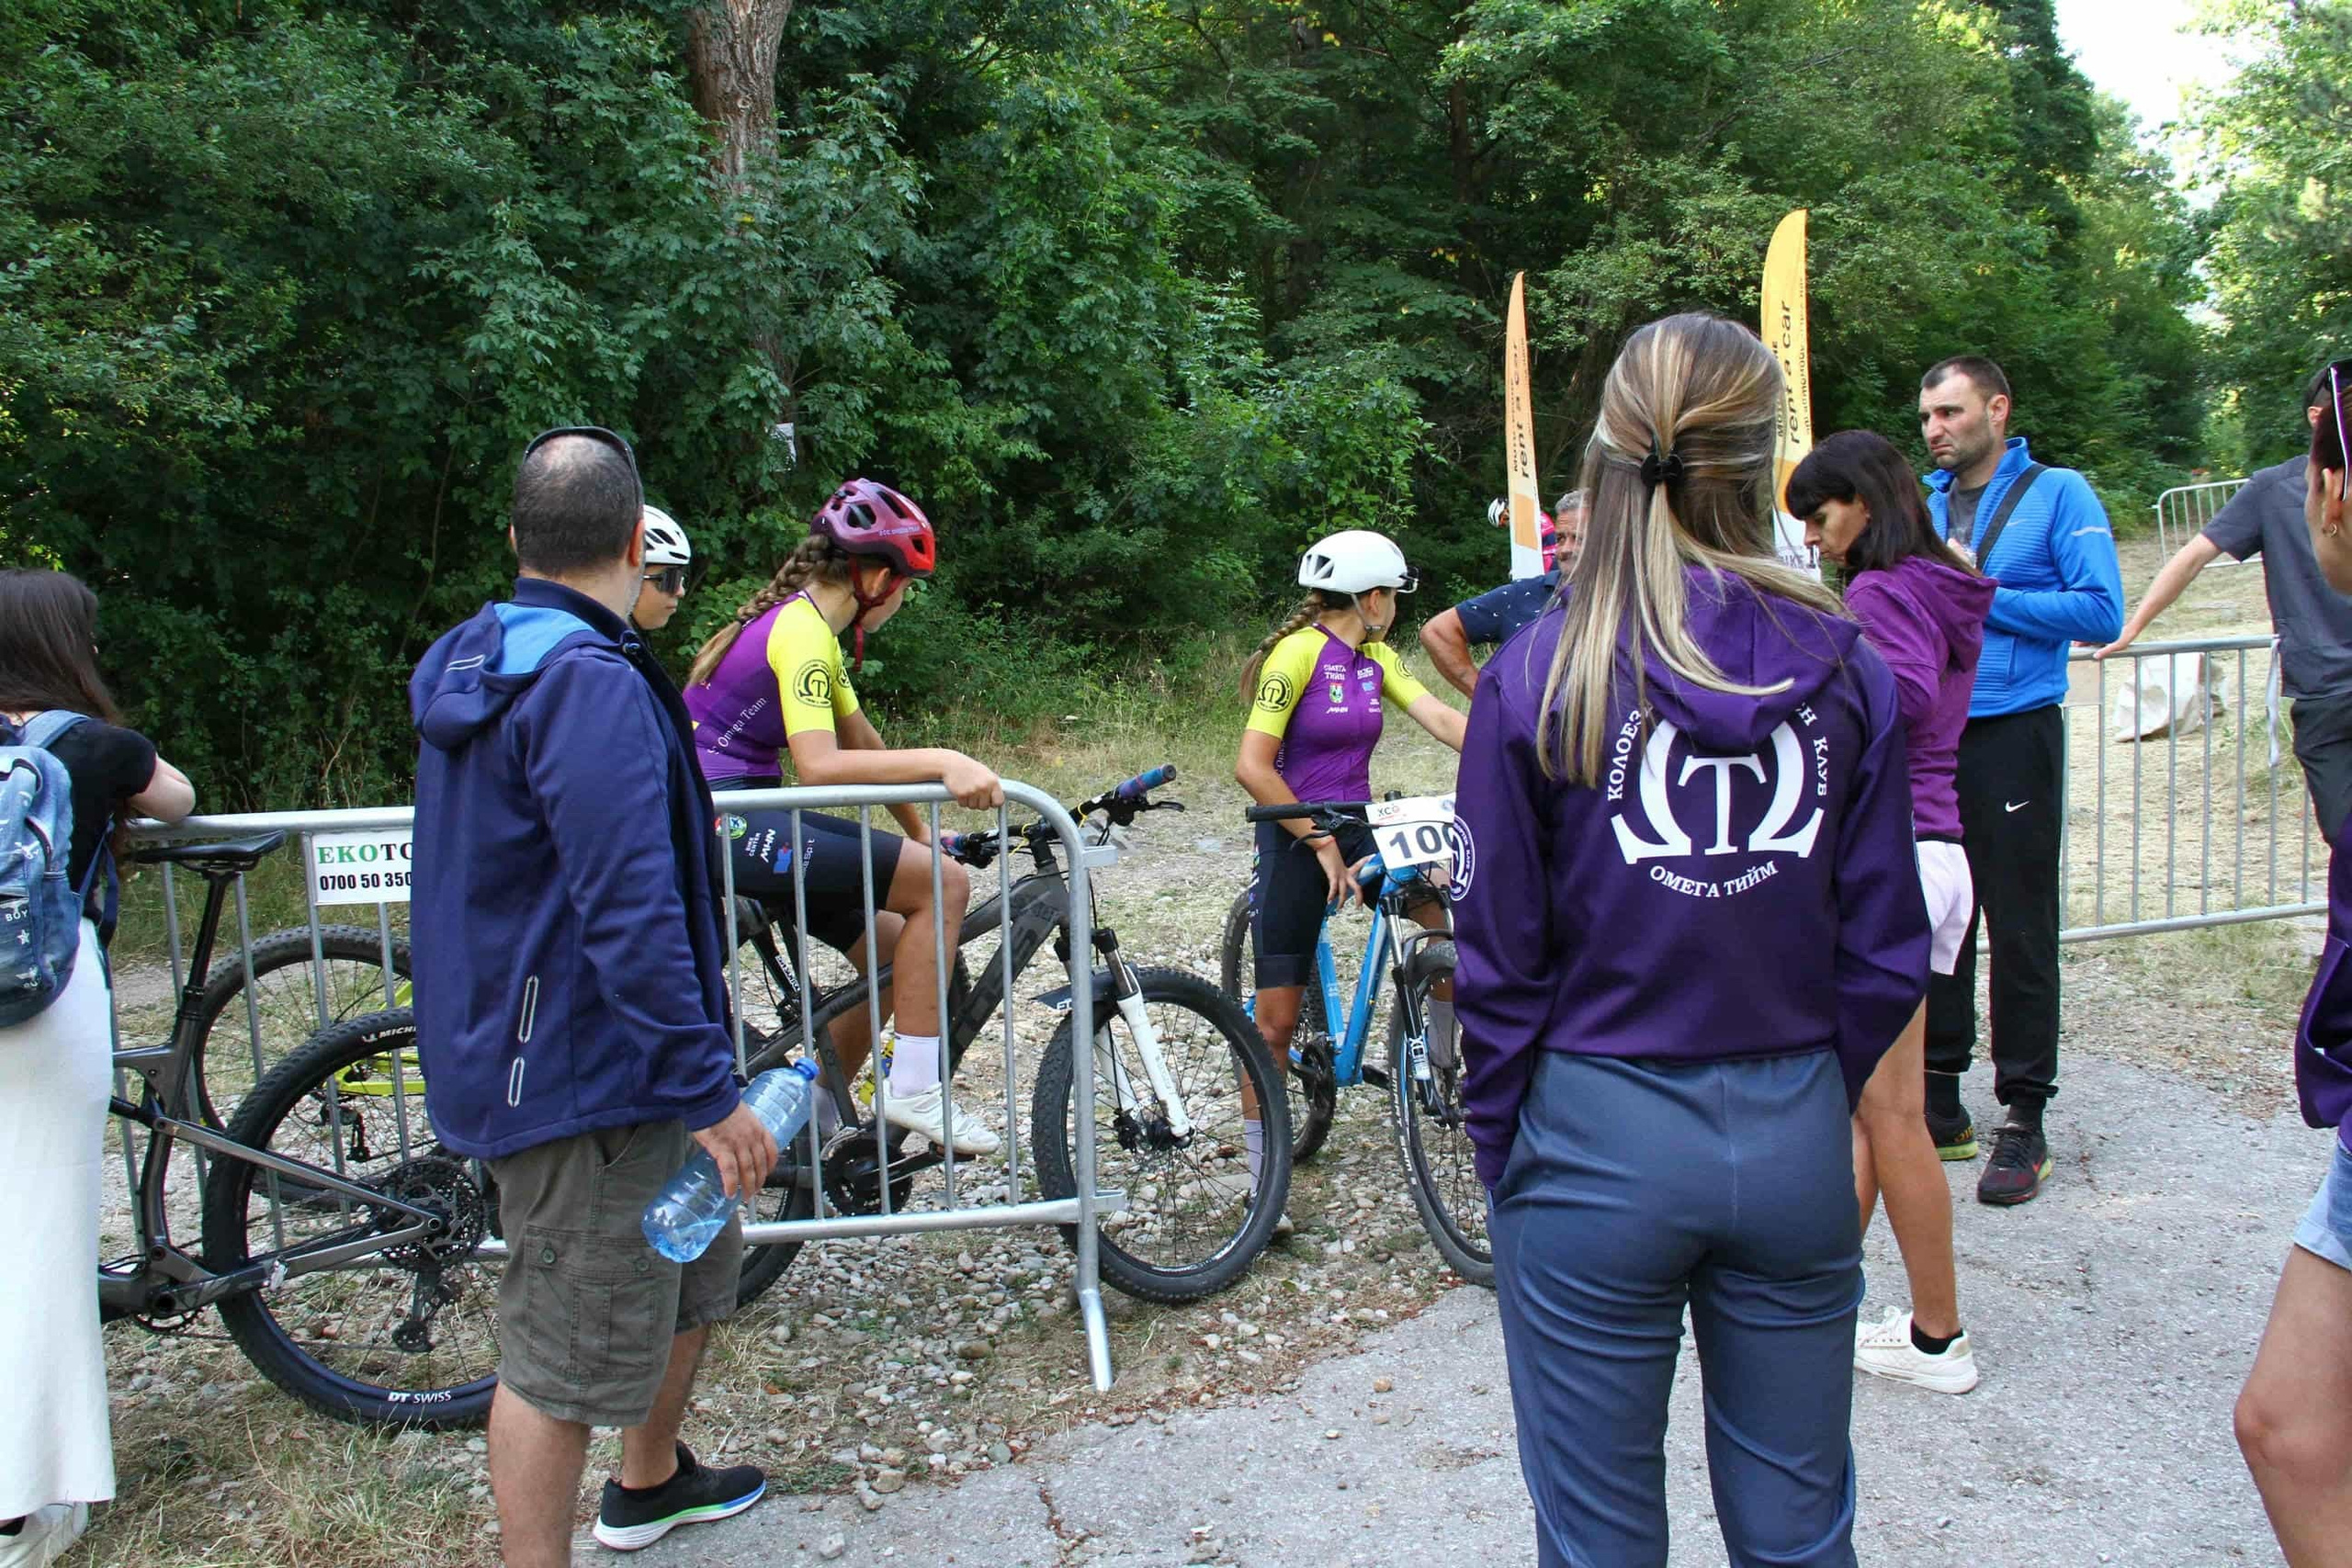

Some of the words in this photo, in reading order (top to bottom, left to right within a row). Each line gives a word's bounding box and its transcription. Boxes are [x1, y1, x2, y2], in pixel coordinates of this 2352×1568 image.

[1781, 299, 1792, 349] car
[1783, 359, 1792, 377] a
[1785, 385, 1801, 444] rent
[1518, 422, 1530, 479] rent
[740, 696, 768, 720] Team
[1814, 736, 1829, 796] КЛУБ
[320, 874, 356, 890] 0700
[360, 873, 380, 888] 50
[1650, 865, 1721, 897] ОМЕГА
[1724, 860, 1779, 896] ТИЙМ
[6, 910, 28, 922] BOY
[388, 1392, 411, 1402] DT
[413, 1391, 452, 1404] SWISS
